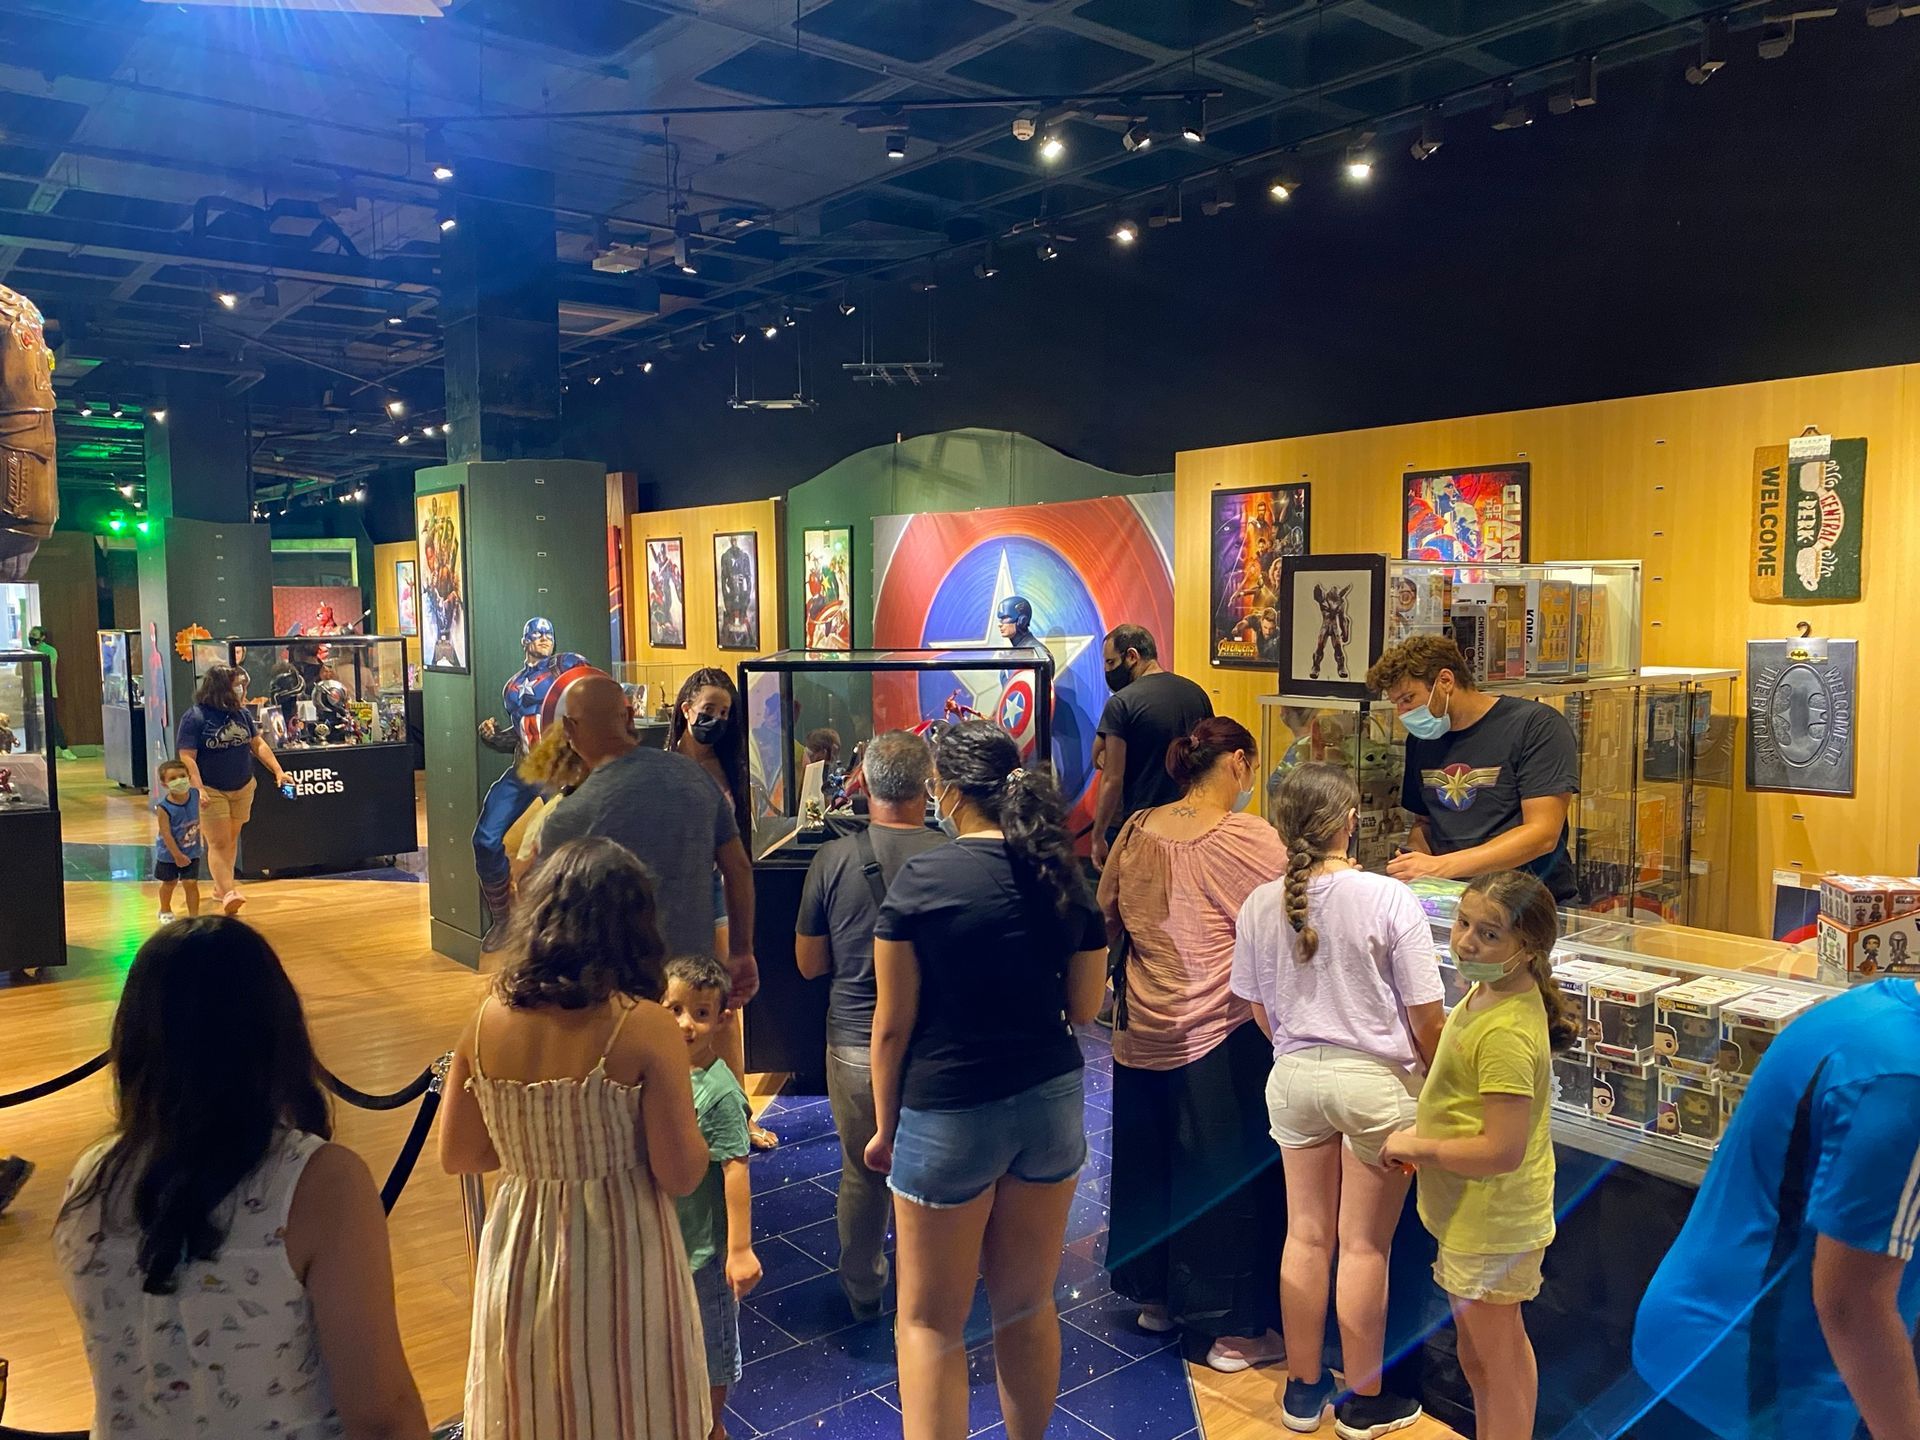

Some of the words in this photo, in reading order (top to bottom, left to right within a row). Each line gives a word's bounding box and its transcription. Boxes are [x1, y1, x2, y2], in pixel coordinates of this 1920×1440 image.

[1757, 466, 1780, 577] WELCOME
[1797, 500, 1818, 541] PERK
[1818, 494, 1842, 547] CENTRAL
[1753, 666, 1780, 695] THE
[1823, 666, 1851, 745] WELCOME
[1751, 697, 1779, 765] BATCAVE
[1822, 747, 1842, 767] TO
[296, 780, 344, 796] EROES
